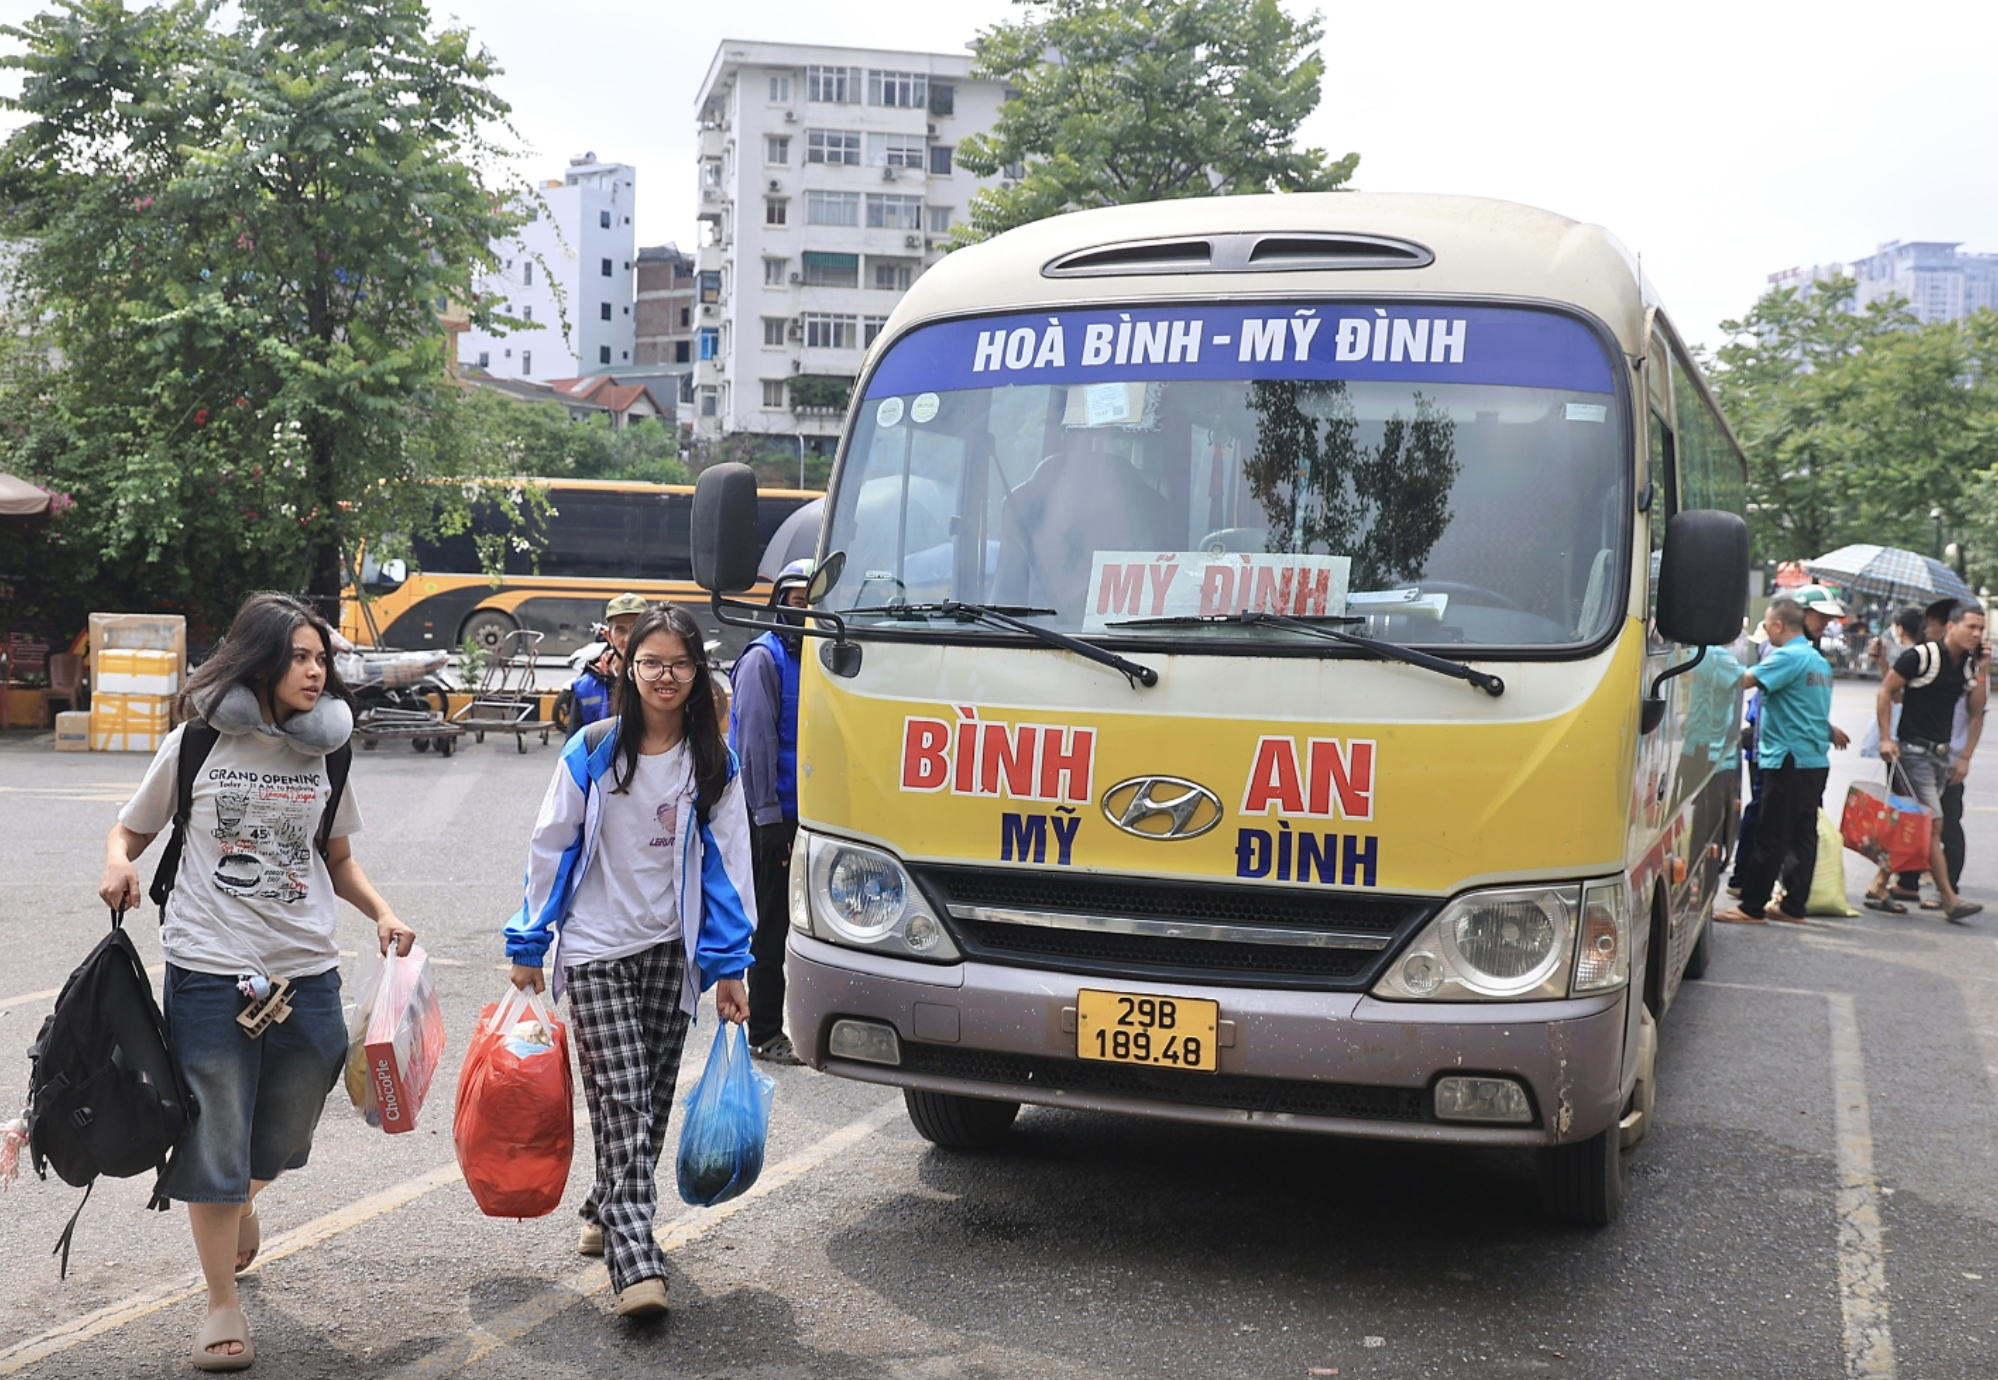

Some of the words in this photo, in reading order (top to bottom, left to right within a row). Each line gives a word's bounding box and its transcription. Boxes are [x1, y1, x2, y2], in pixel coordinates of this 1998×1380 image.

[973, 317, 1066, 372] HOÀ
[1081, 313, 1204, 366] BÌNH
[1238, 308, 1321, 362] MỸ
[1335, 308, 1467, 363] ĐÌNH
[1096, 553, 1180, 616] MỸ
[1200, 554, 1331, 617] ĐÌNH
[209, 768, 258, 782] GRAND
[262, 774, 320, 787] OPENING
[900, 704, 1096, 803] BÌNH
[1239, 735, 1376, 821] AN
[1000, 805, 1082, 866] MỸ
[1235, 820, 1378, 887] ĐÌNH
[1117, 997, 1176, 1029] 29B
[1096, 1029, 1201, 1066] 189.48
